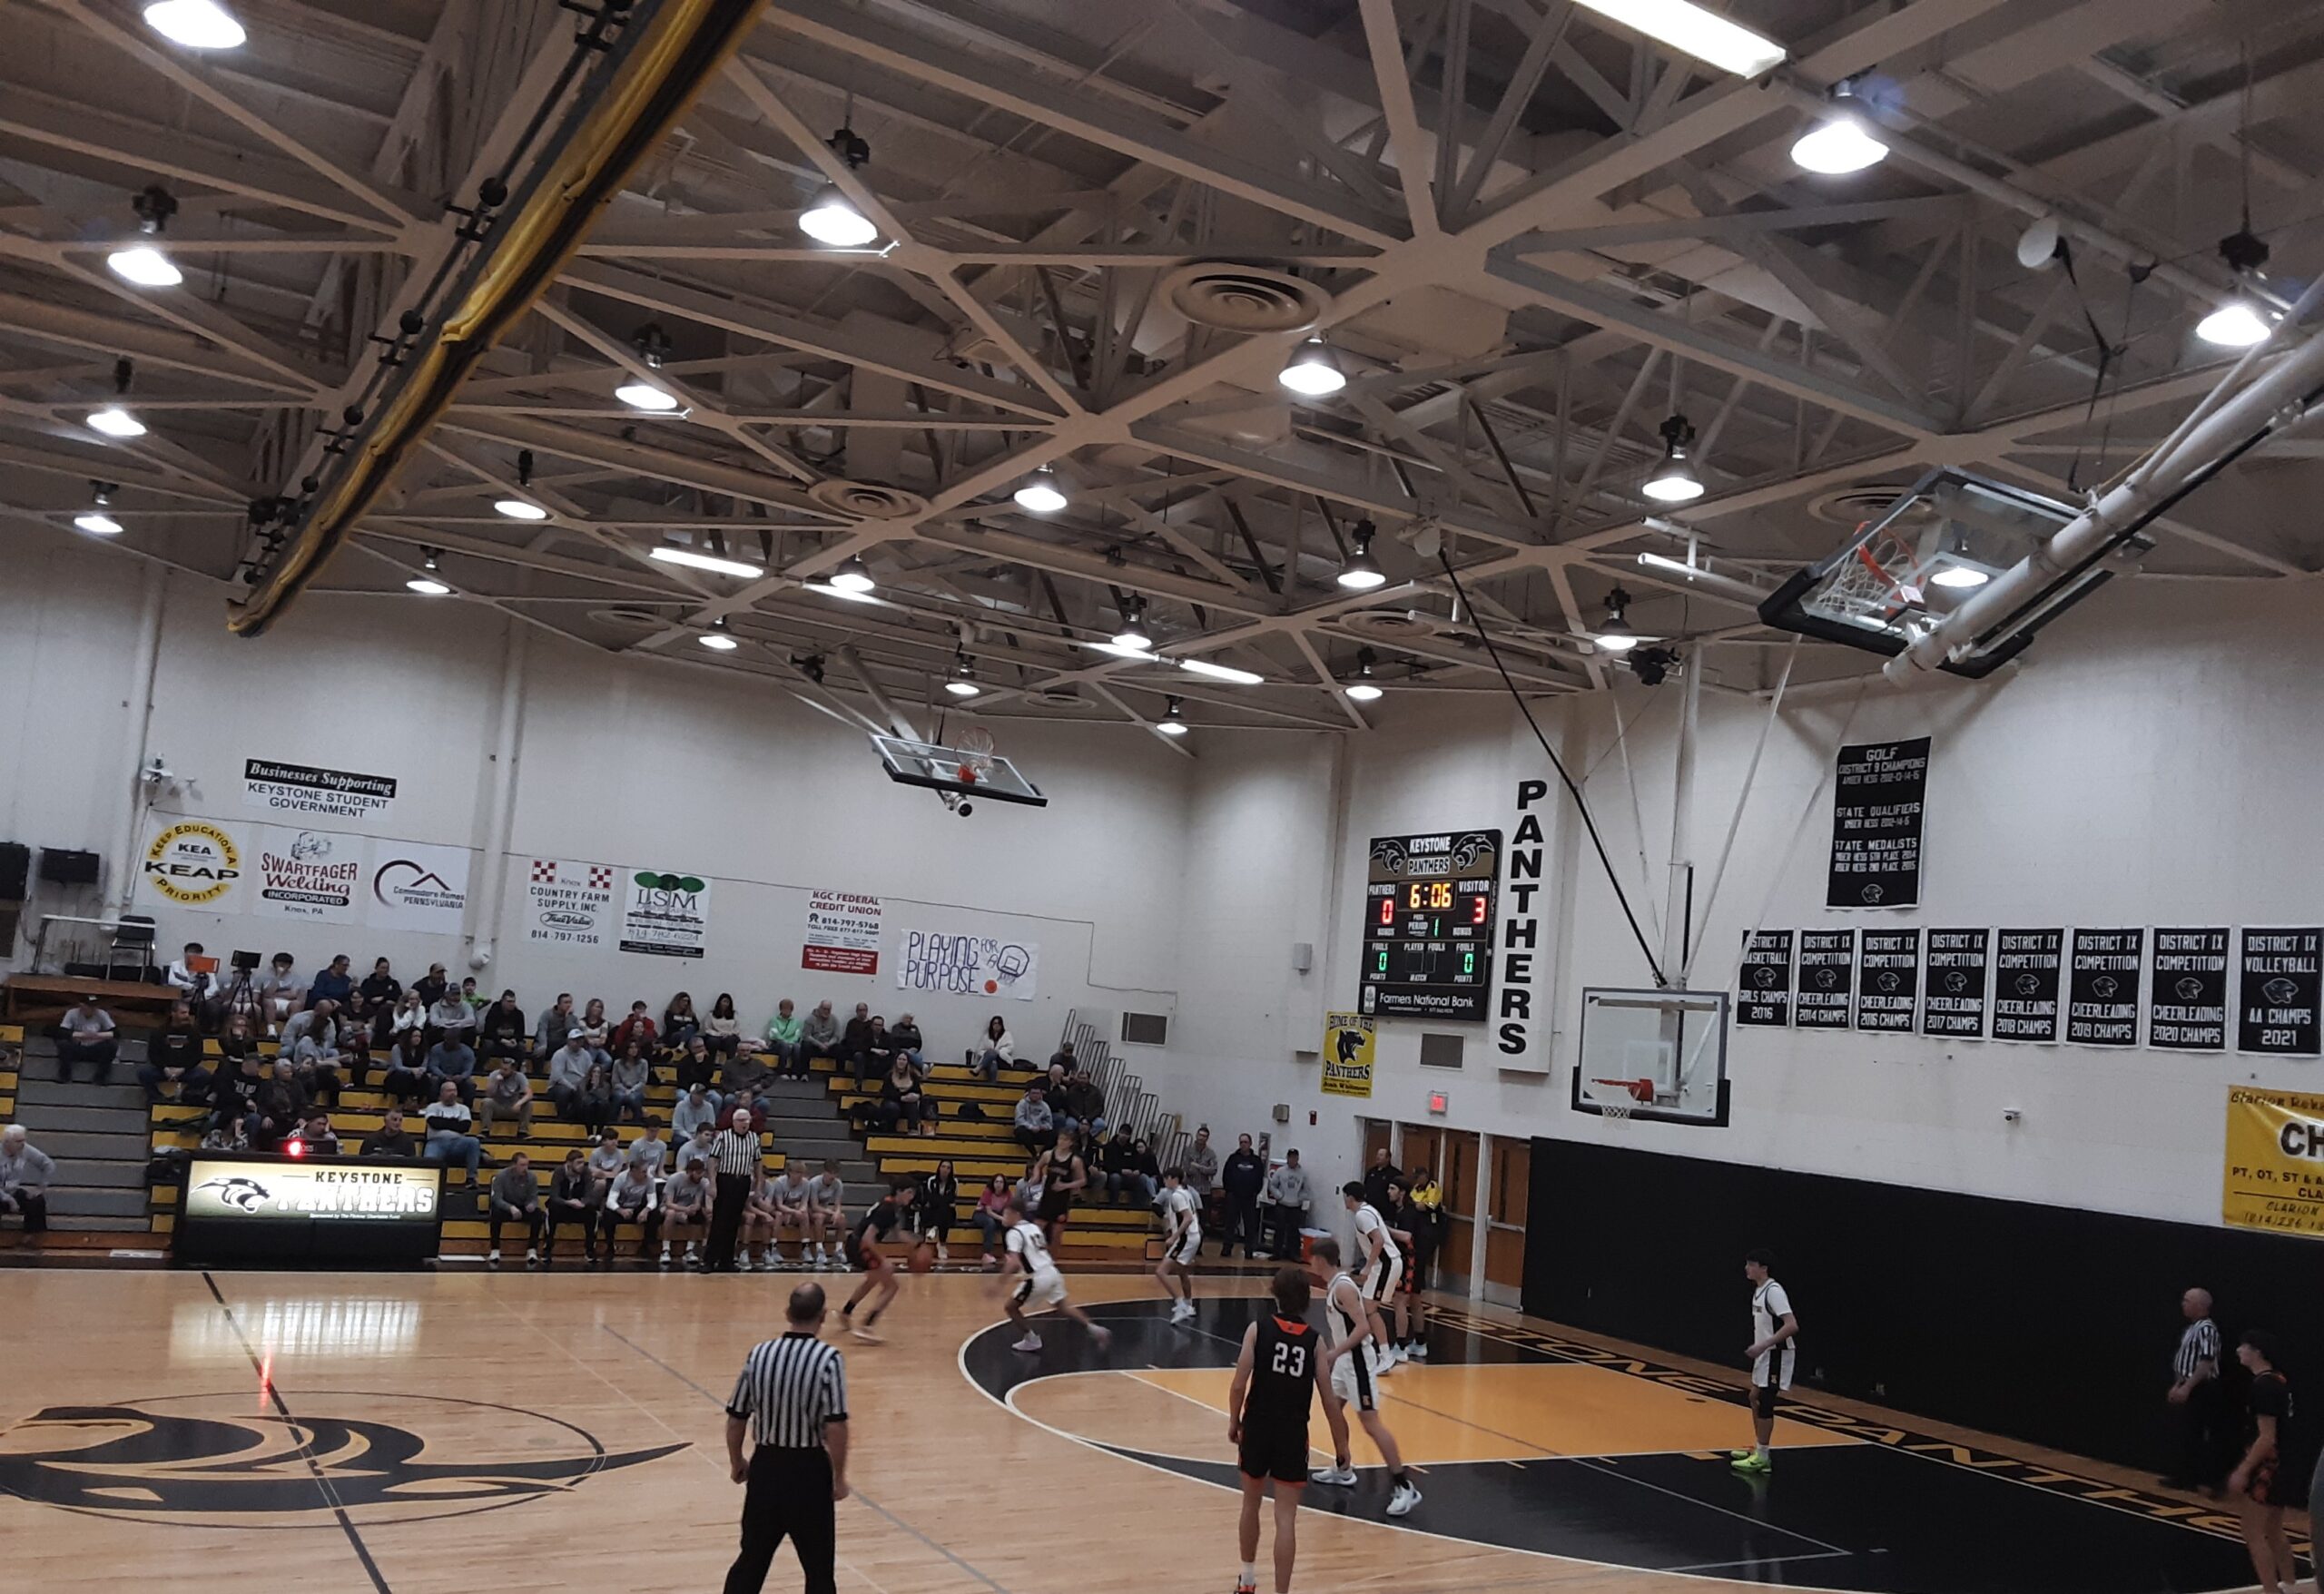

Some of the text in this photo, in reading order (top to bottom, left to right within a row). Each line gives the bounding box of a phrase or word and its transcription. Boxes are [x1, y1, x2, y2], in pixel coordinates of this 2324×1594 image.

[1866, 747, 1898, 761] GOLF
[1838, 763, 1872, 774] DISTRICT
[1881, 757, 1925, 772] CHAMPIONS
[250, 763, 393, 795] Businesses Supporting
[248, 782, 389, 809] KEYSTONE STUDENT
[270, 797, 366, 818] GOVERNMENT
[1837, 802, 1921, 817] STATE QUALIFIERS
[151, 832, 172, 857] KEEP
[174, 824, 232, 853] EDUCATION
[227, 856, 237, 864] A
[178, 843, 211, 855] KEA
[1409, 836, 1452, 853] KEYSTONE
[1835, 838, 1917, 851] STATE MEDALISTS
[145, 861, 239, 881] KEAP
[261, 852, 358, 881] SWARTFAGER
[1408, 857, 1450, 875] PANTHERS
[156, 878, 222, 900] PRIORITY
[266, 873, 350, 897] Welding
[1459, 881, 1490, 893] VISITOR
[268, 890, 344, 905] INCORPORATED
[403, 896, 463, 909] PENNSYLVANIA
[530, 887, 610, 903] COUNTRY FARM
[812, 890, 880, 906] KGC FEDERAL
[1410, 883, 1452, 909] 6:06
[809, 901, 881, 916] CREDIT UNION
[1382, 900, 1394, 924] 0
[1472, 897, 1486, 924] 3
[822, 917, 879, 930] 814-797-5768
[1408, 921, 1429, 930] PERIOD
[1498, 780, 1548, 1055] PANTHERS
[1433, 917, 1440, 938] 1
[1372, 942, 1389, 950] FOULS
[1403, 943, 1446, 951] PLAYER FOULS
[1456, 943, 1474, 951] FOULS
[1751, 936, 1789, 949] STRICT IX
[1804, 935, 1851, 949] DISTRICT IX
[1866, 937, 1915, 950] DISTRICT IX
[1932, 934, 1984, 949] DISTRICT IX
[2002, 935, 2058, 950] DISTRICT IX
[2077, 935, 2138, 950] DISTRICT IX
[2159, 934, 2224, 950] DISTRICT IX
[2247, 935, 2317, 952] DISTRICT IX
[909, 931, 999, 969] PLAYING FOR A
[1744, 951, 1787, 965] ASKETBALL
[1378, 952, 1388, 971] 0
[1463, 953, 1474, 973] 0
[1801, 952, 1851, 965] COMPETITION
[1863, 954, 1915, 968] COMPETITION
[1929, 953, 1984, 967] COMPETITION
[1999, 954, 2058, 969] COMPETITION
[2074, 955, 2138, 970] COMPETITION
[2156, 955, 2225, 971] COMPETITION
[2245, 957, 2318, 973] VOLLEYBALL
[905, 959, 980, 993] PURPOSE
[1380, 992, 1474, 1008] Farmers National Bank
[1738, 989, 1787, 1004] GIRLS CHAMPS
[1798, 992, 1848, 1005] CHEERLEADING
[1860, 996, 1914, 1010] CHEERLEADING
[1926, 997, 1983, 1012] CHEERLEADING
[1751, 1007, 1773, 1019] 2016
[1996, 999, 2056, 1015] CHEERLEADING
[2072, 1002, 2135, 1018] CHEERLEADING
[2152, 1005, 2224, 1022] CHEERLEADING
[1798, 1009, 1846, 1022] 2014 CHAMPS
[1879, 1013, 1910, 1028] CHAMPS
[1927, 1015, 1978, 1030] 2017 CHAMPS
[2249, 1008, 2311, 1025] AA CHAMPS
[1328, 1016, 1374, 1033] HOME OF THE
[1996, 1018, 2052, 1034] 2018 CHAMPS
[2093, 1023, 2132, 1039] CHAMPS
[2153, 1026, 2221, 1044] 2020 CHAMPS
[2261, 1029, 2297, 1046] 2021
[1325, 1060, 1371, 1080] PANTHERS
[2230, 1090, 2285, 1107] Clarion
[315, 1171, 403, 1185] KEYSTONE
[2232, 1166, 2252, 1179] PT,
[2257, 1168, 2278, 1182] OT,
[2282, 1172, 2299, 1183] ST
[2266, 1202, 2319, 1216] CLARION
[1272, 1342, 1306, 1378] 23
